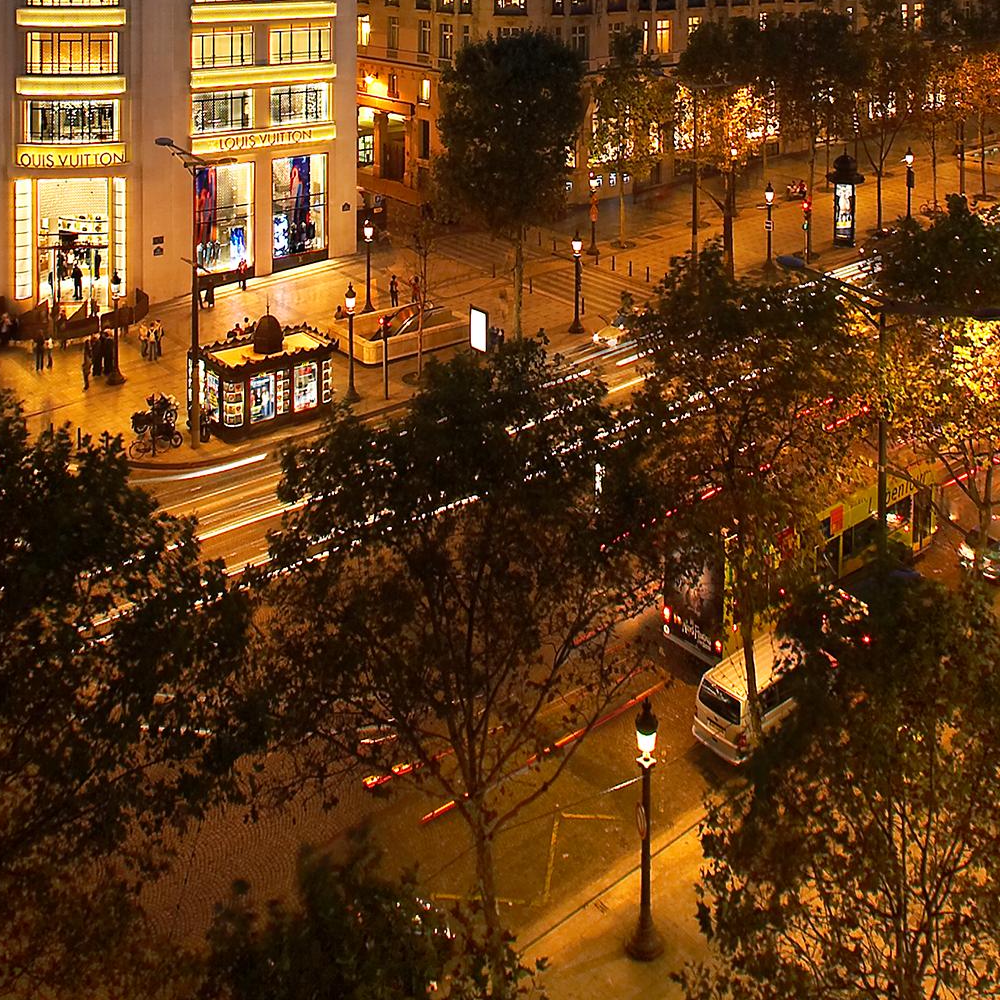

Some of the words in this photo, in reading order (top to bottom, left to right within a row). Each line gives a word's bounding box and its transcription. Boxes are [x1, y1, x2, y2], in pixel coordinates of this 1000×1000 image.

[219, 135, 256, 150] LOUIS
[259, 130, 312, 146] VUITTON
[58, 152, 125, 168] VUITTON
